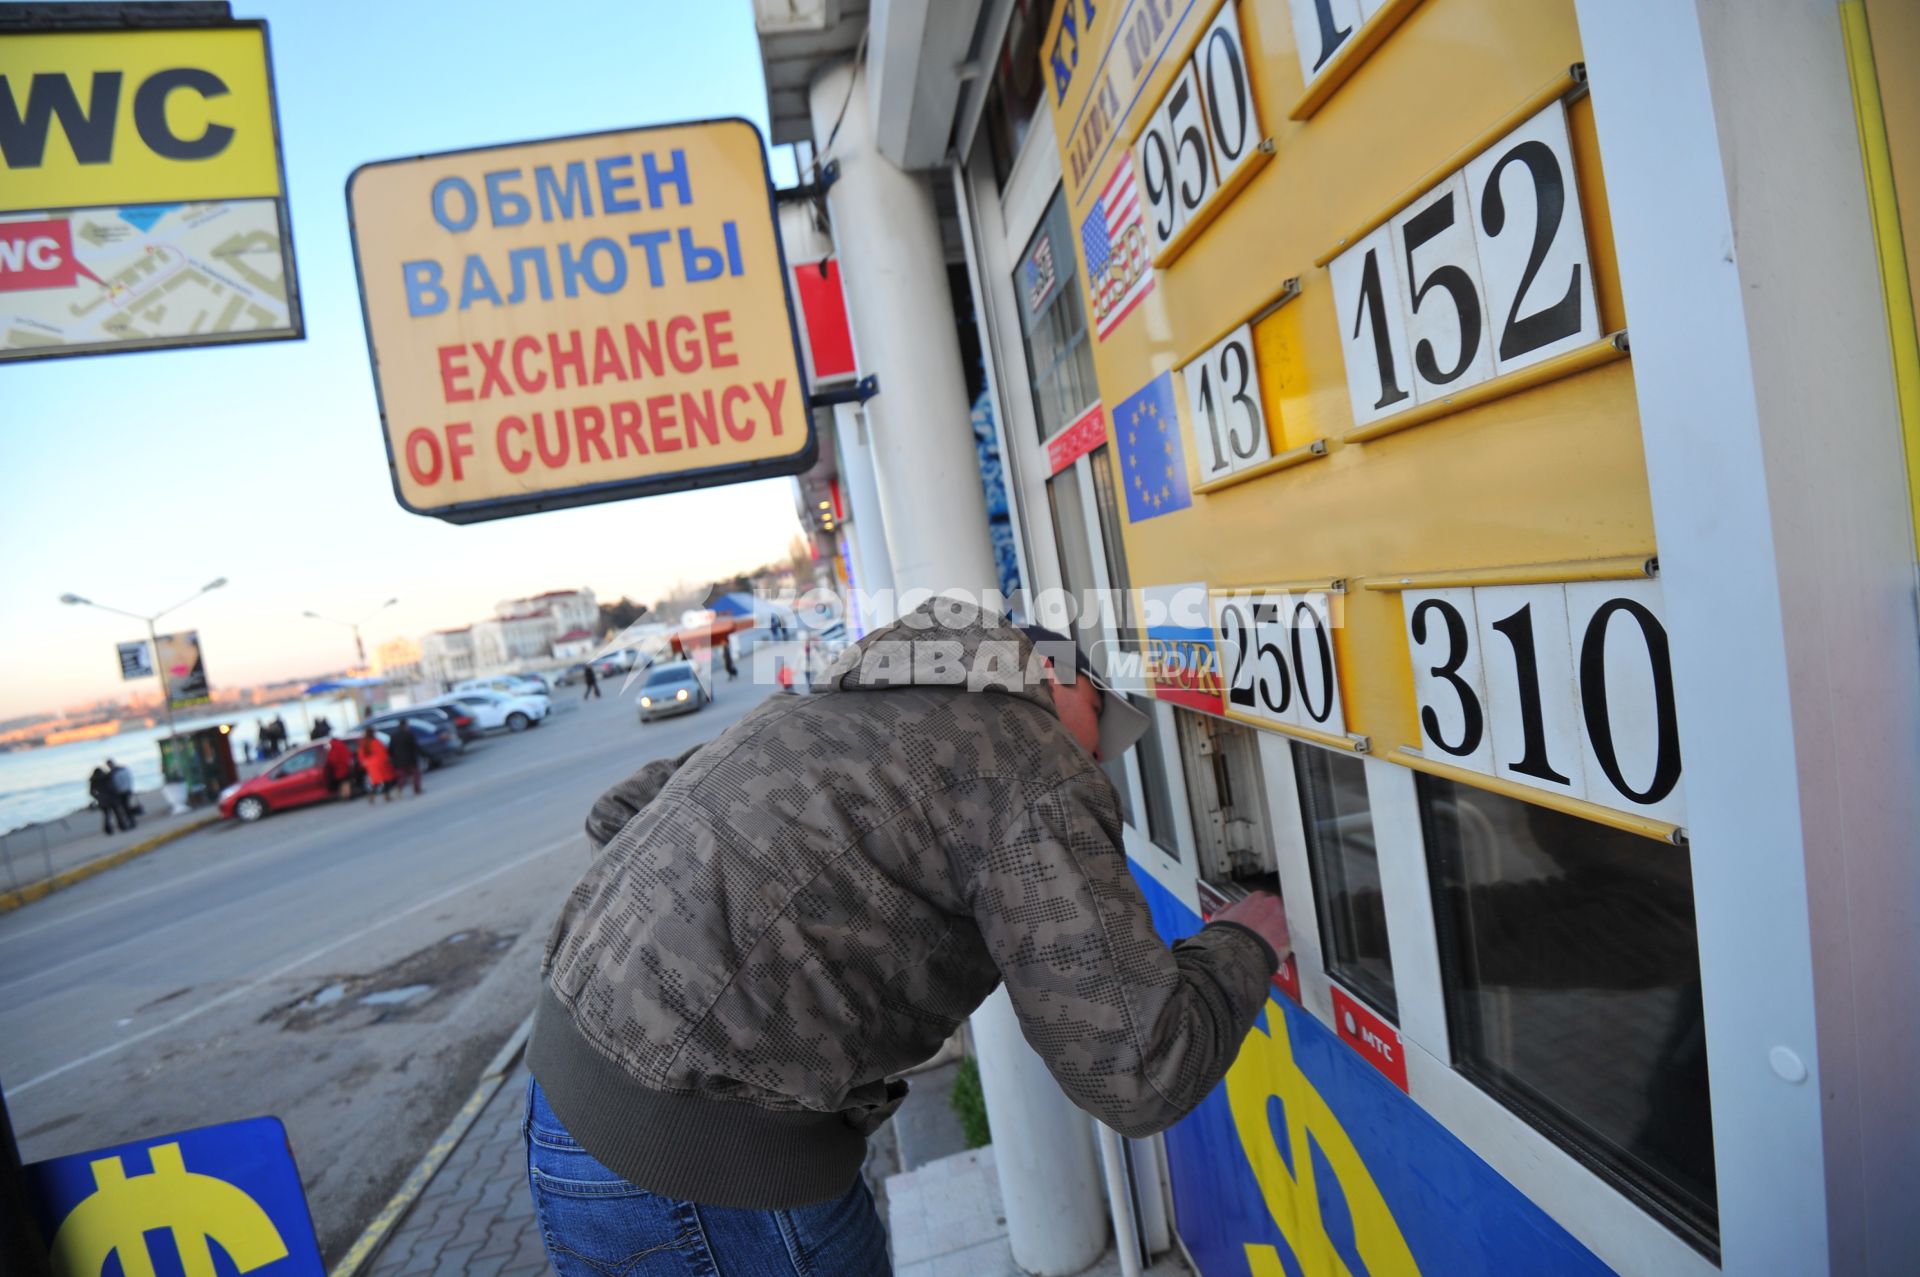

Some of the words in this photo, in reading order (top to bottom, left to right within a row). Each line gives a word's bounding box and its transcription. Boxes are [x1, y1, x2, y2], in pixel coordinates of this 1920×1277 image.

[0, 68, 236, 169] WC
[1143, 27, 1247, 241] 950
[431, 148, 694, 233] ОБМЕН
[401, 221, 744, 317] ВАЛЮТЫ
[1089, 222, 1146, 319] USD
[1353, 141, 1581, 410] 152
[437, 310, 739, 403] EXCHANGE
[1199, 340, 1260, 473] 13
[405, 422, 475, 487] OF
[496, 379, 787, 475] CURRENCY
[1220, 601, 1334, 723] 250
[1411, 598, 1682, 805] 310
